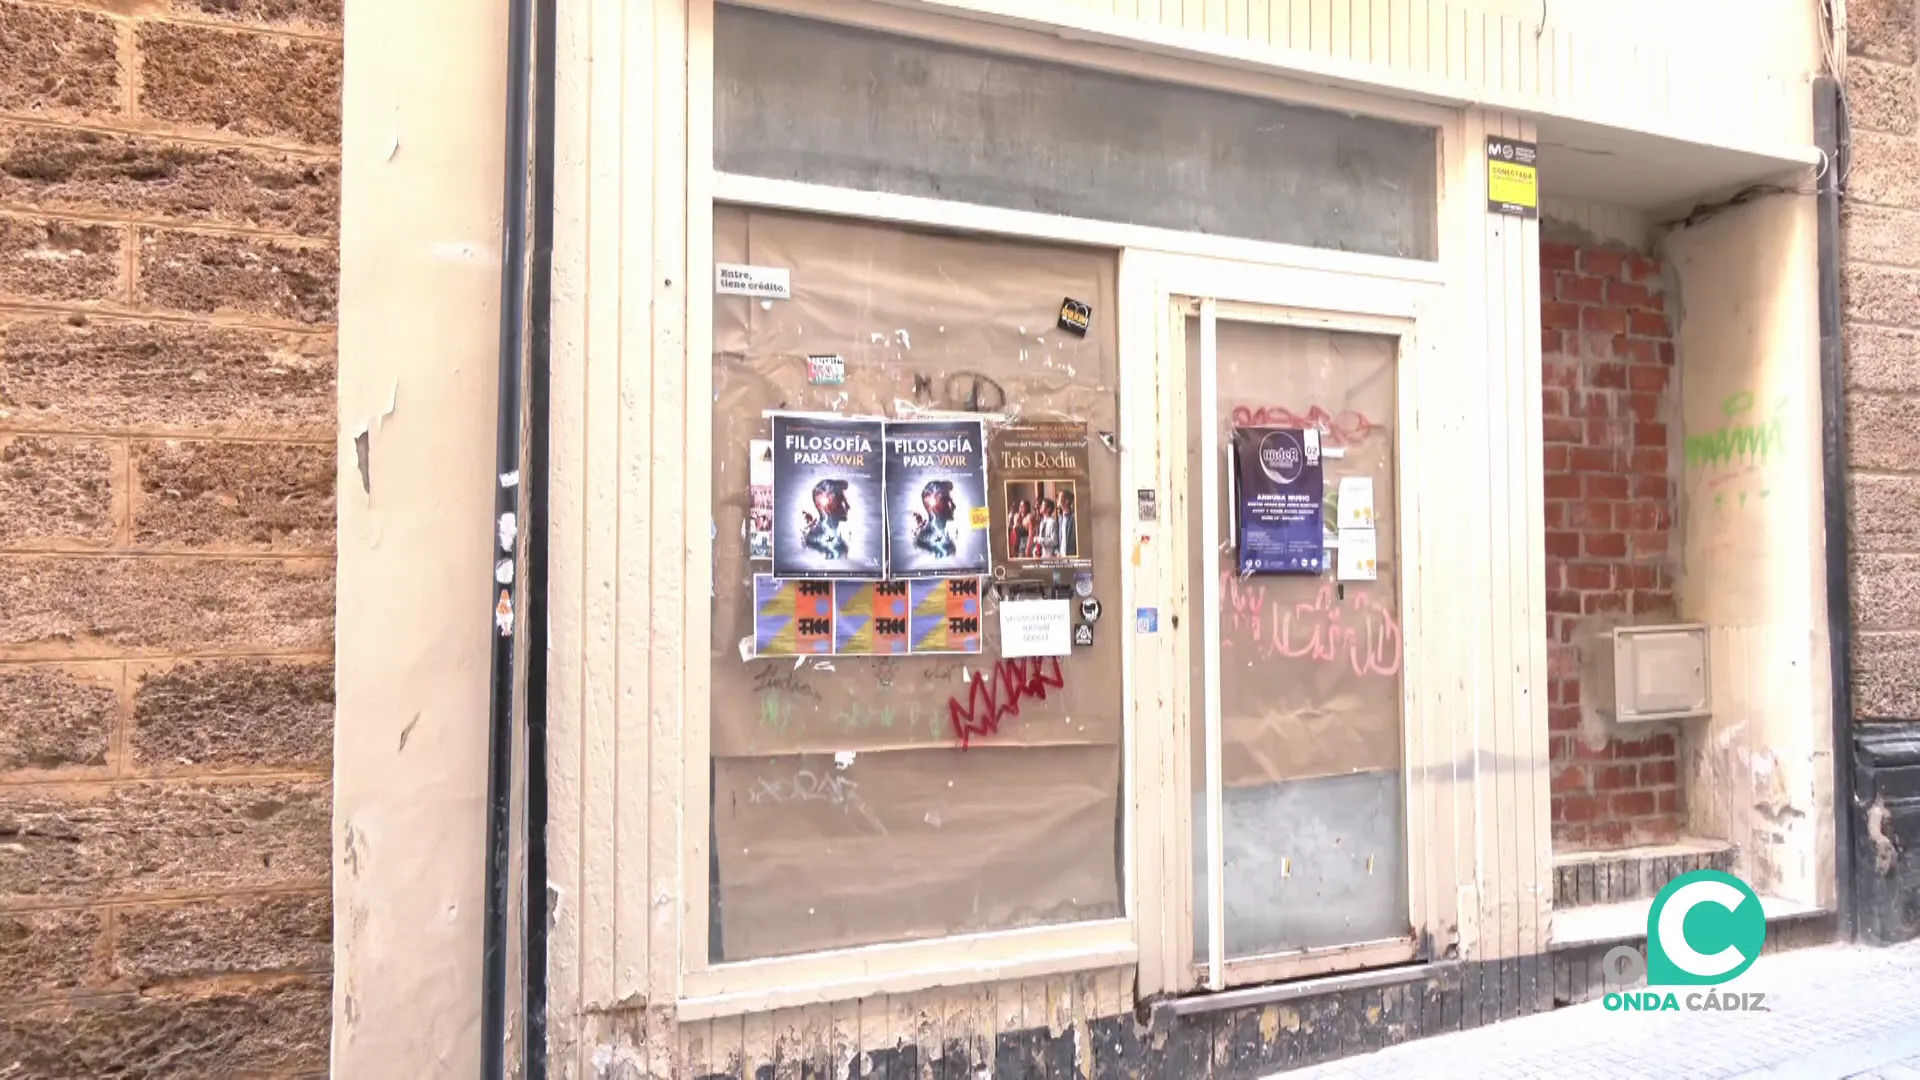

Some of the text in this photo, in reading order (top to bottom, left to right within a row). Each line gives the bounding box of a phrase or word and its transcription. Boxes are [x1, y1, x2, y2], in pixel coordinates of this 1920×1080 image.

[720, 268, 753, 281] Entre,
[720, 278, 787, 293] tiene crédito.
[785, 434, 873, 454] FILOSOFÍA
[894, 434, 973, 453] FILOSOFÍA
[1306, 446, 1318, 455] 02
[794, 452, 865, 467] PARA VIVIR
[903, 454, 967, 467] PARA VIVIR
[1034, 450, 1076, 469] Rodin
